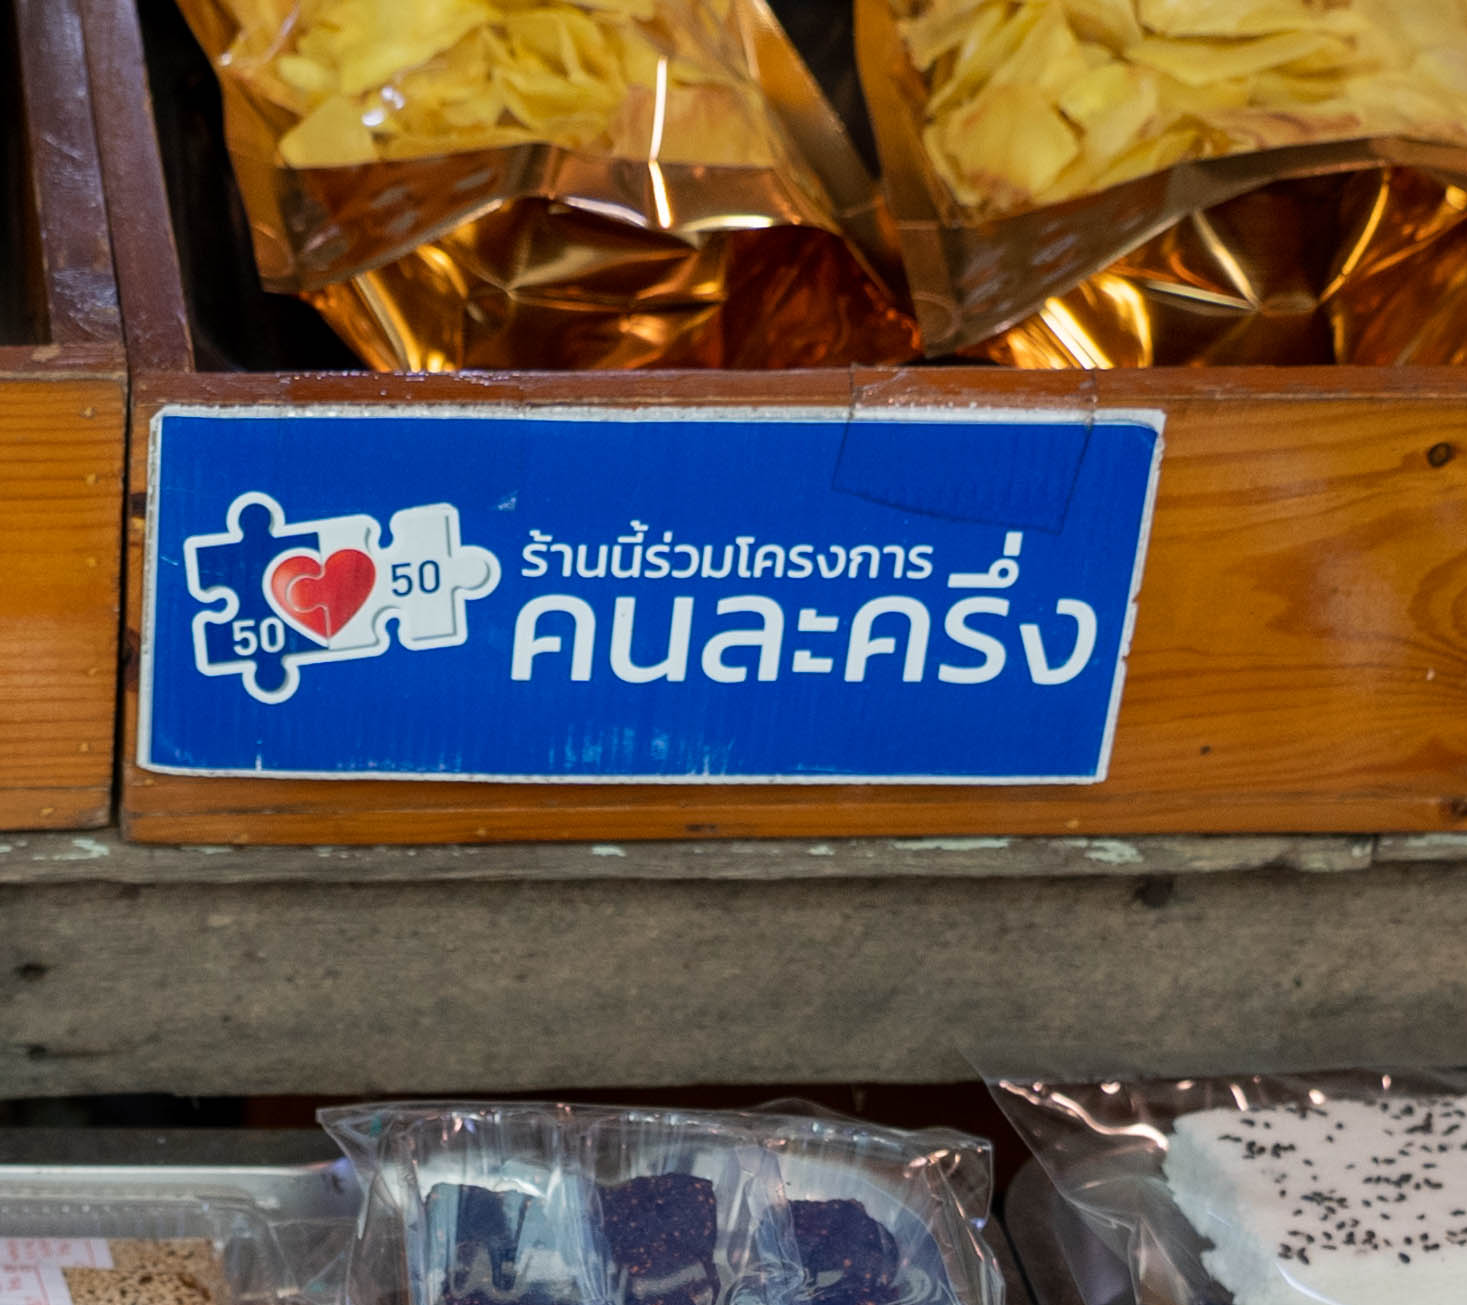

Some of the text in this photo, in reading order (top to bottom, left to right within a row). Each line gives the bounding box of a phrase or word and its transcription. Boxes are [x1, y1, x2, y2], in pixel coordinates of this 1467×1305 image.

[520, 519, 934, 580] ร้านนี้ร่วมโครงการ
[390, 559, 441, 598] 50
[510, 531, 1099, 686] คนละครึ่ง
[231, 616, 286, 657] 50
